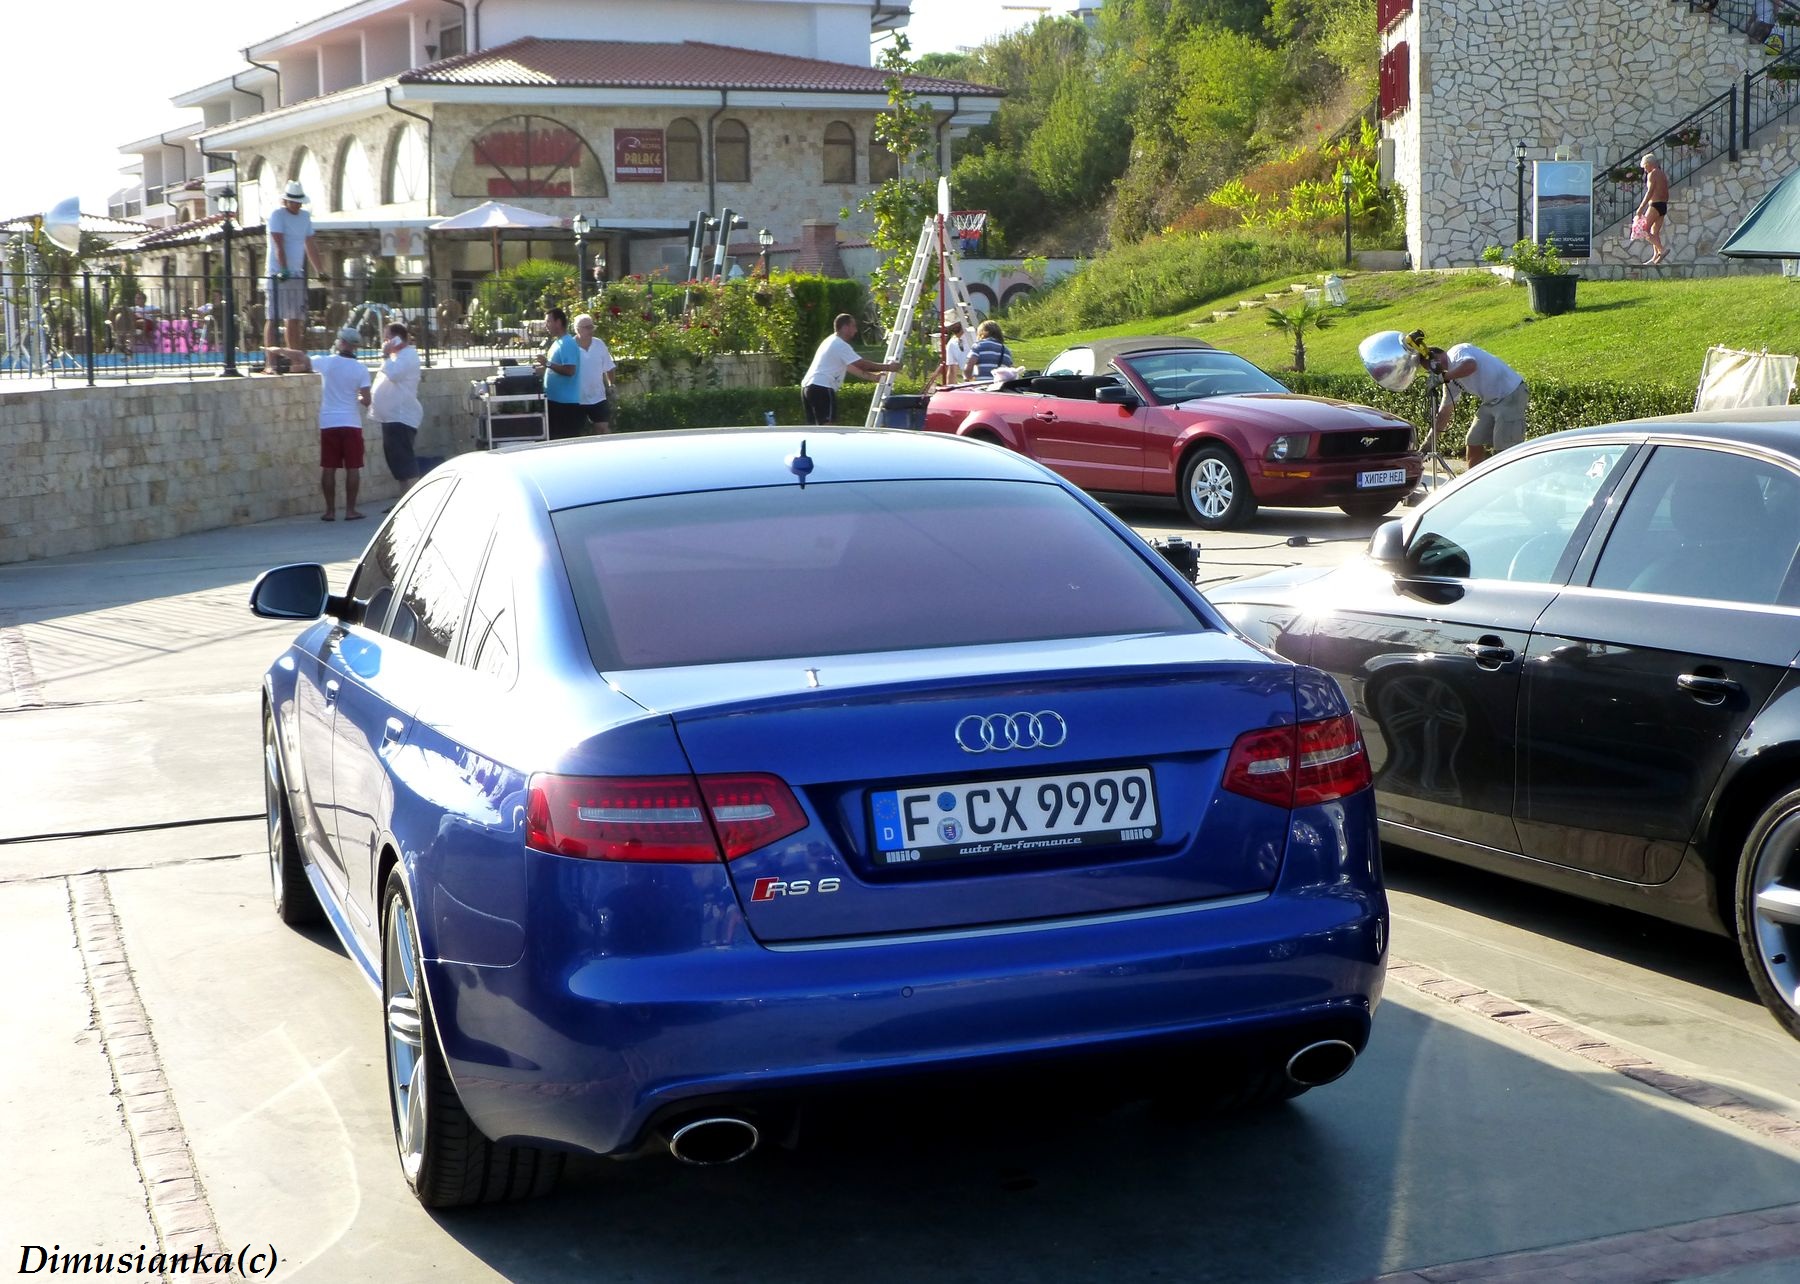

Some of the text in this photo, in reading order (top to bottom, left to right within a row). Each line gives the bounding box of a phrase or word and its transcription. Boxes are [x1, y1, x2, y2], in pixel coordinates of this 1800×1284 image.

[1364, 471, 1404, 485] ХИПЕР НЕД
[903, 776, 1147, 842] F CX 9999
[883, 827, 895, 841] D
[959, 837, 1082, 854] auto Performance
[817, 877, 841, 893] 6
